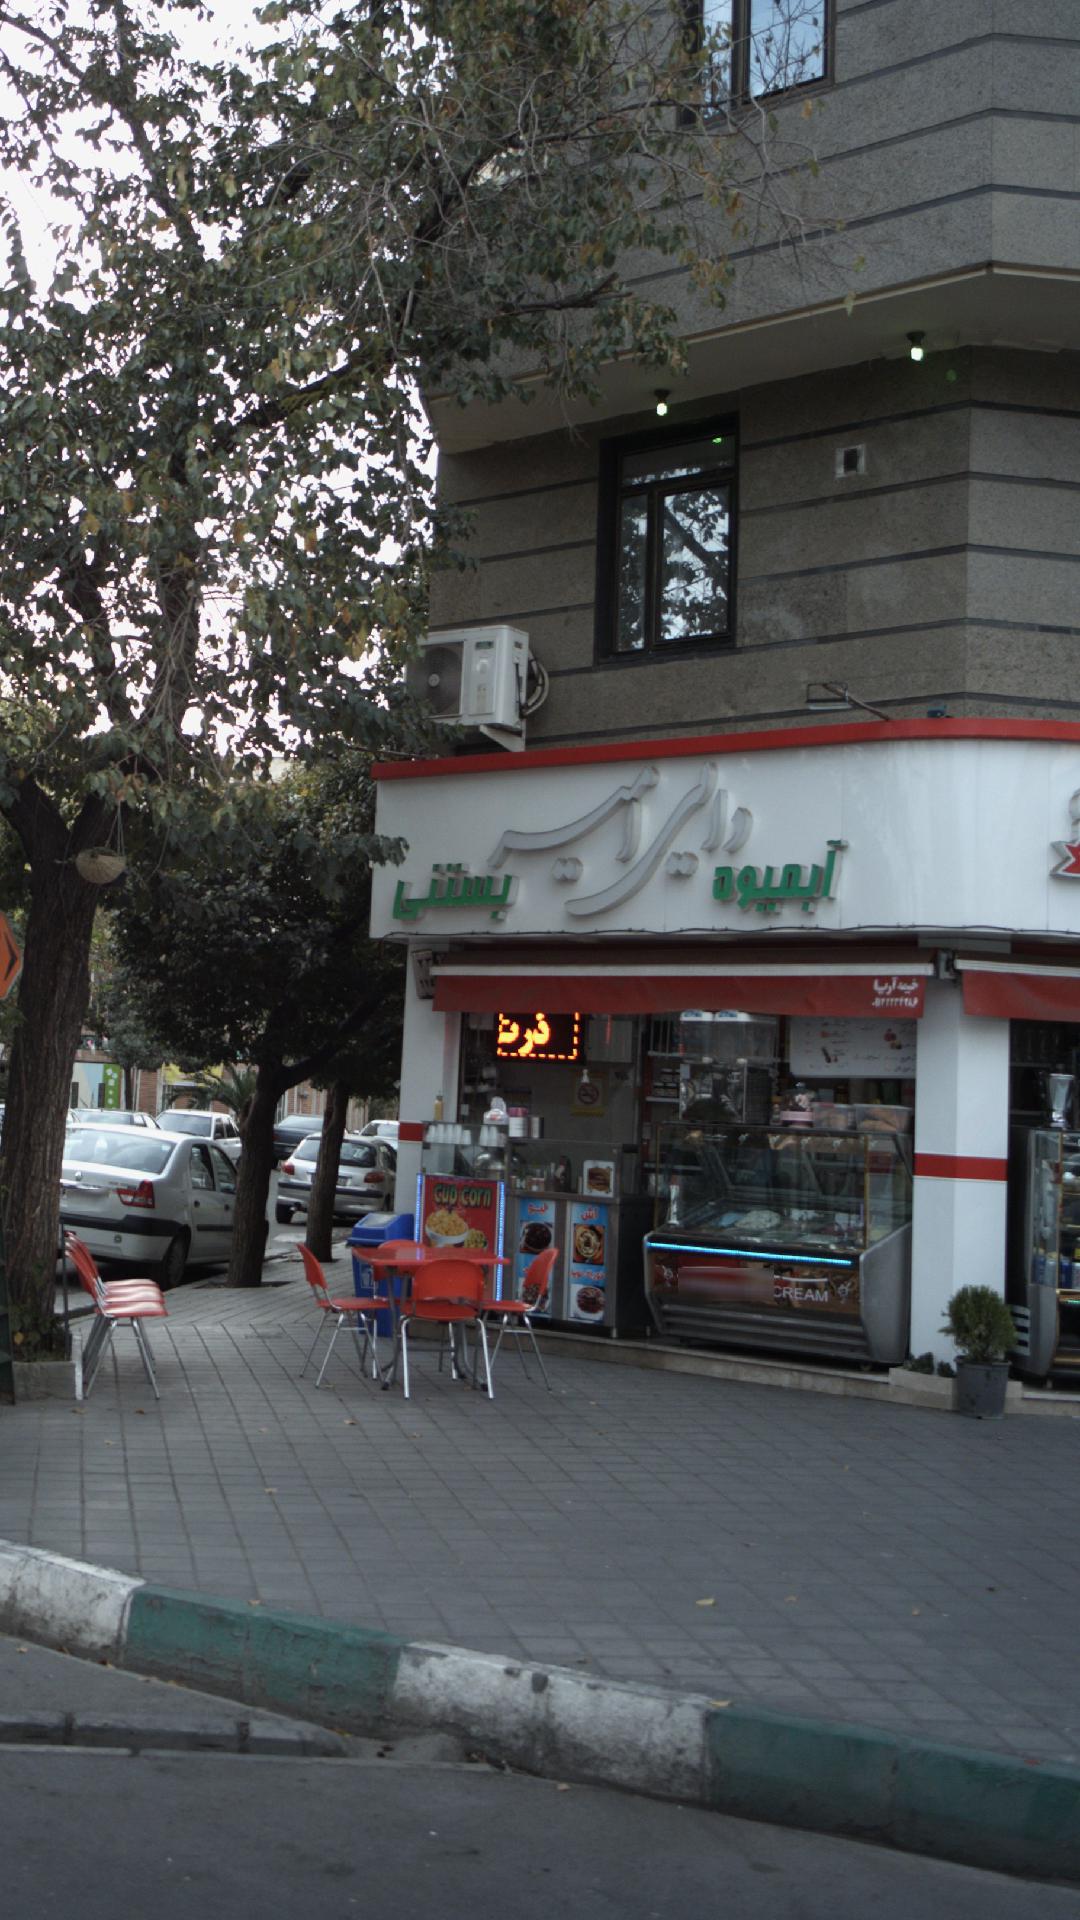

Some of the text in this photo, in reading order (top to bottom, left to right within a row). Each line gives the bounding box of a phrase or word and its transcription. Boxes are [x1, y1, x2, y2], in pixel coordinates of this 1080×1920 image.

[393, 863, 517, 921] بستنی
[712, 840, 845, 913] آبمیوه
[773, 1286, 828, 1302] CREAM
